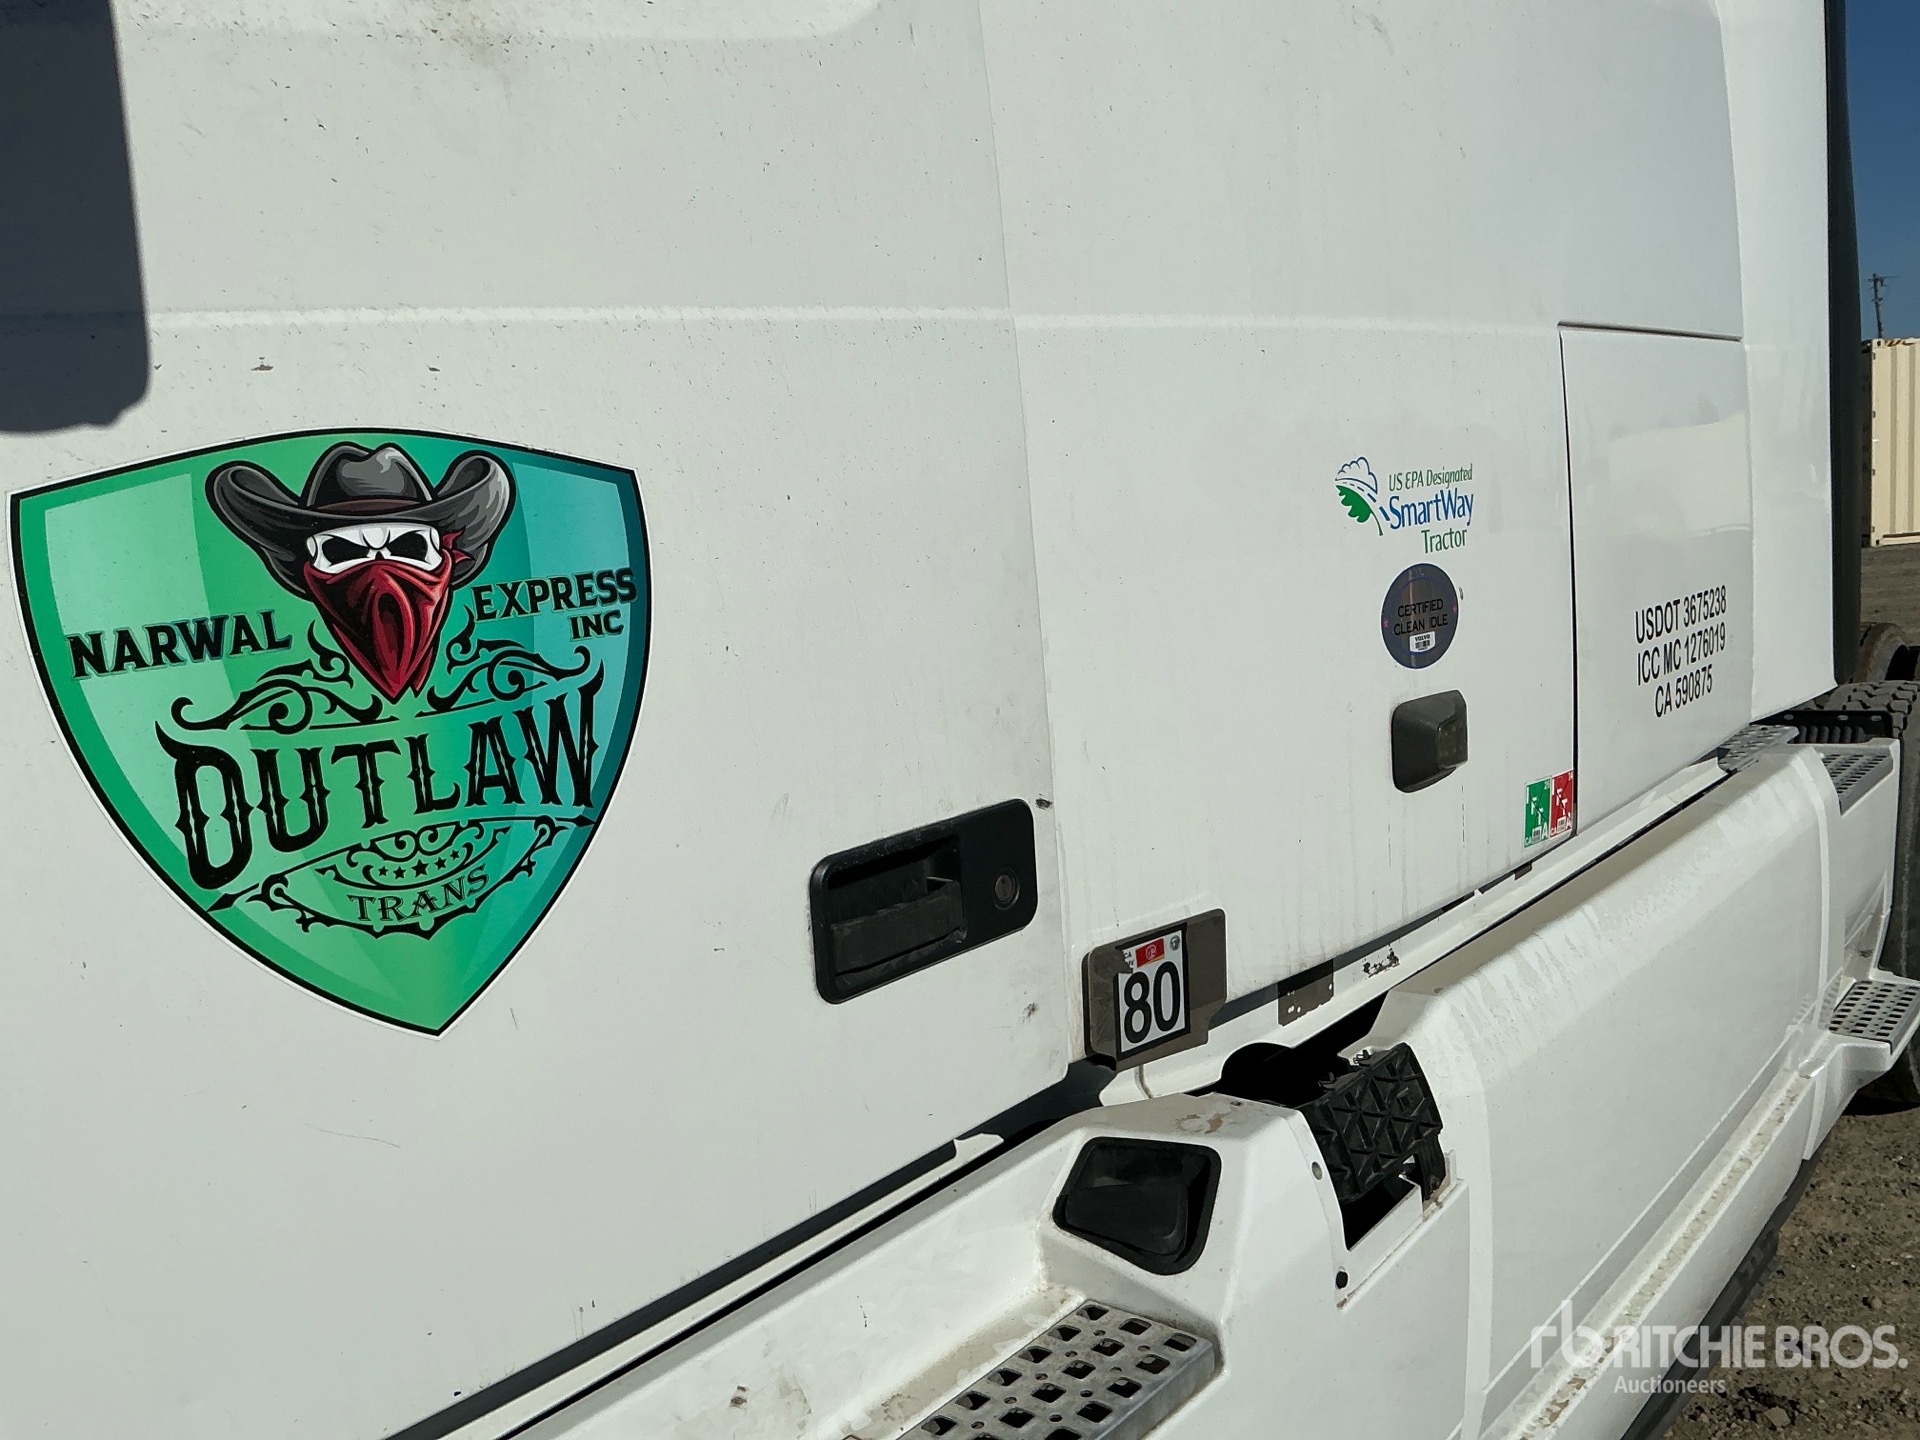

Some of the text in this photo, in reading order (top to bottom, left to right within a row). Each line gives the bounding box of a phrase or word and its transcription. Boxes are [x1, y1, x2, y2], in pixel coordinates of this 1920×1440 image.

[1389, 463, 1473, 492] US EPA Designated
[1389, 487, 1474, 530] SmartWay
[1421, 528, 1468, 554] Tractor
[471, 567, 637, 622] EXPRESS
[1398, 598, 1444, 618] CERTIFIED
[1635, 585, 1727, 644] USDOT 3675238
[66, 609, 293, 679] NARWAL
[568, 609, 624, 640] INC
[1393, 614, 1449, 636] CLEAN IDLE
[1637, 621, 1726, 686] ICC MC 1276019
[1655, 663, 1713, 718] CA 590875
[155, 658, 605, 890] OUTLAW
[346, 863, 489, 922] TRANS
[1124, 961, 1181, 1043] 80
